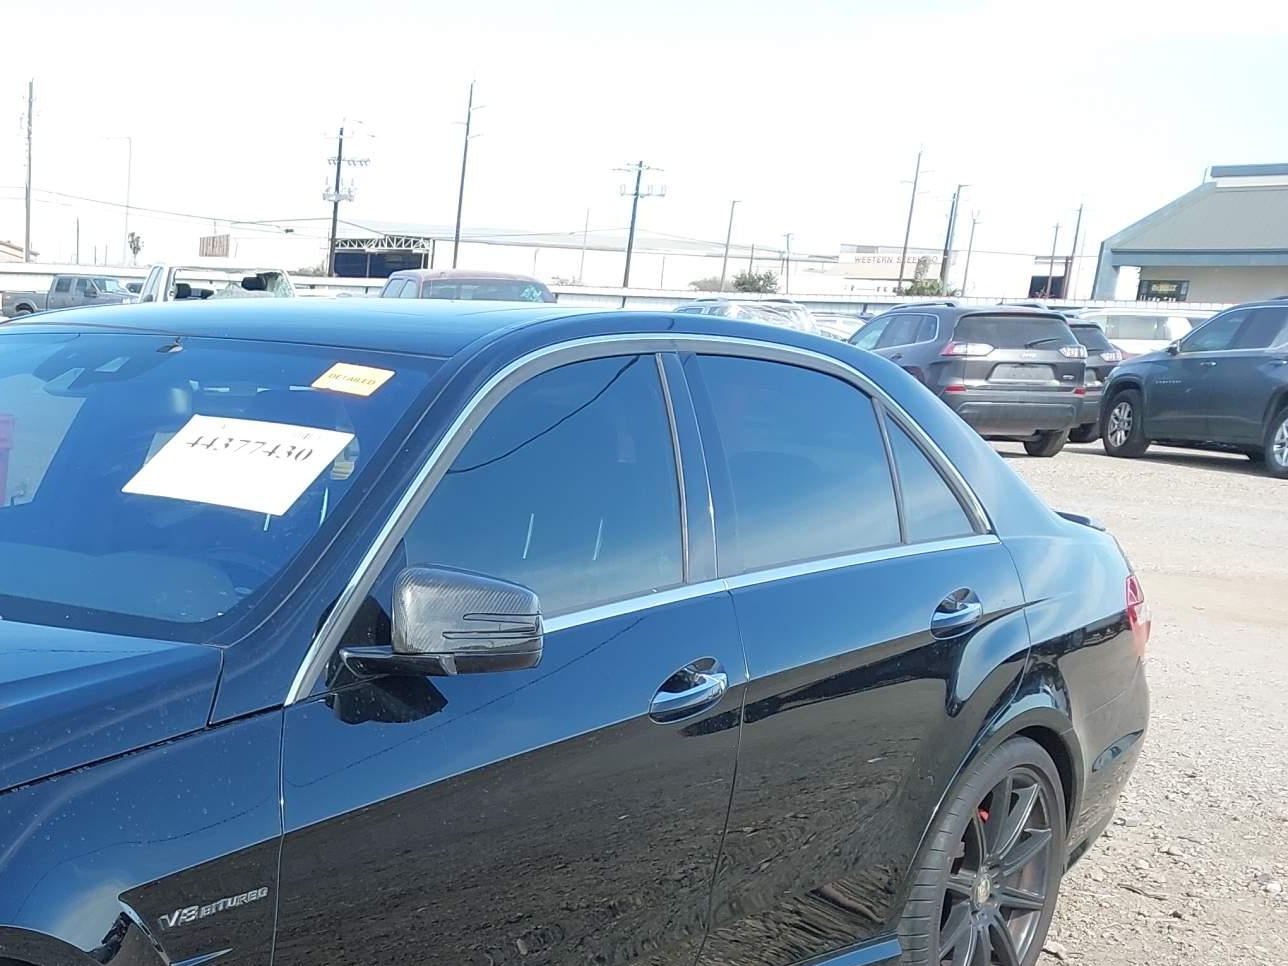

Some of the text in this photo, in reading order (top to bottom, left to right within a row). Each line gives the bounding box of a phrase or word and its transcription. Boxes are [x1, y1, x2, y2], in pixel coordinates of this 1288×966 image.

[185, 435, 314, 462] 44377430
[159, 886, 269, 931] V8 BITURBO
